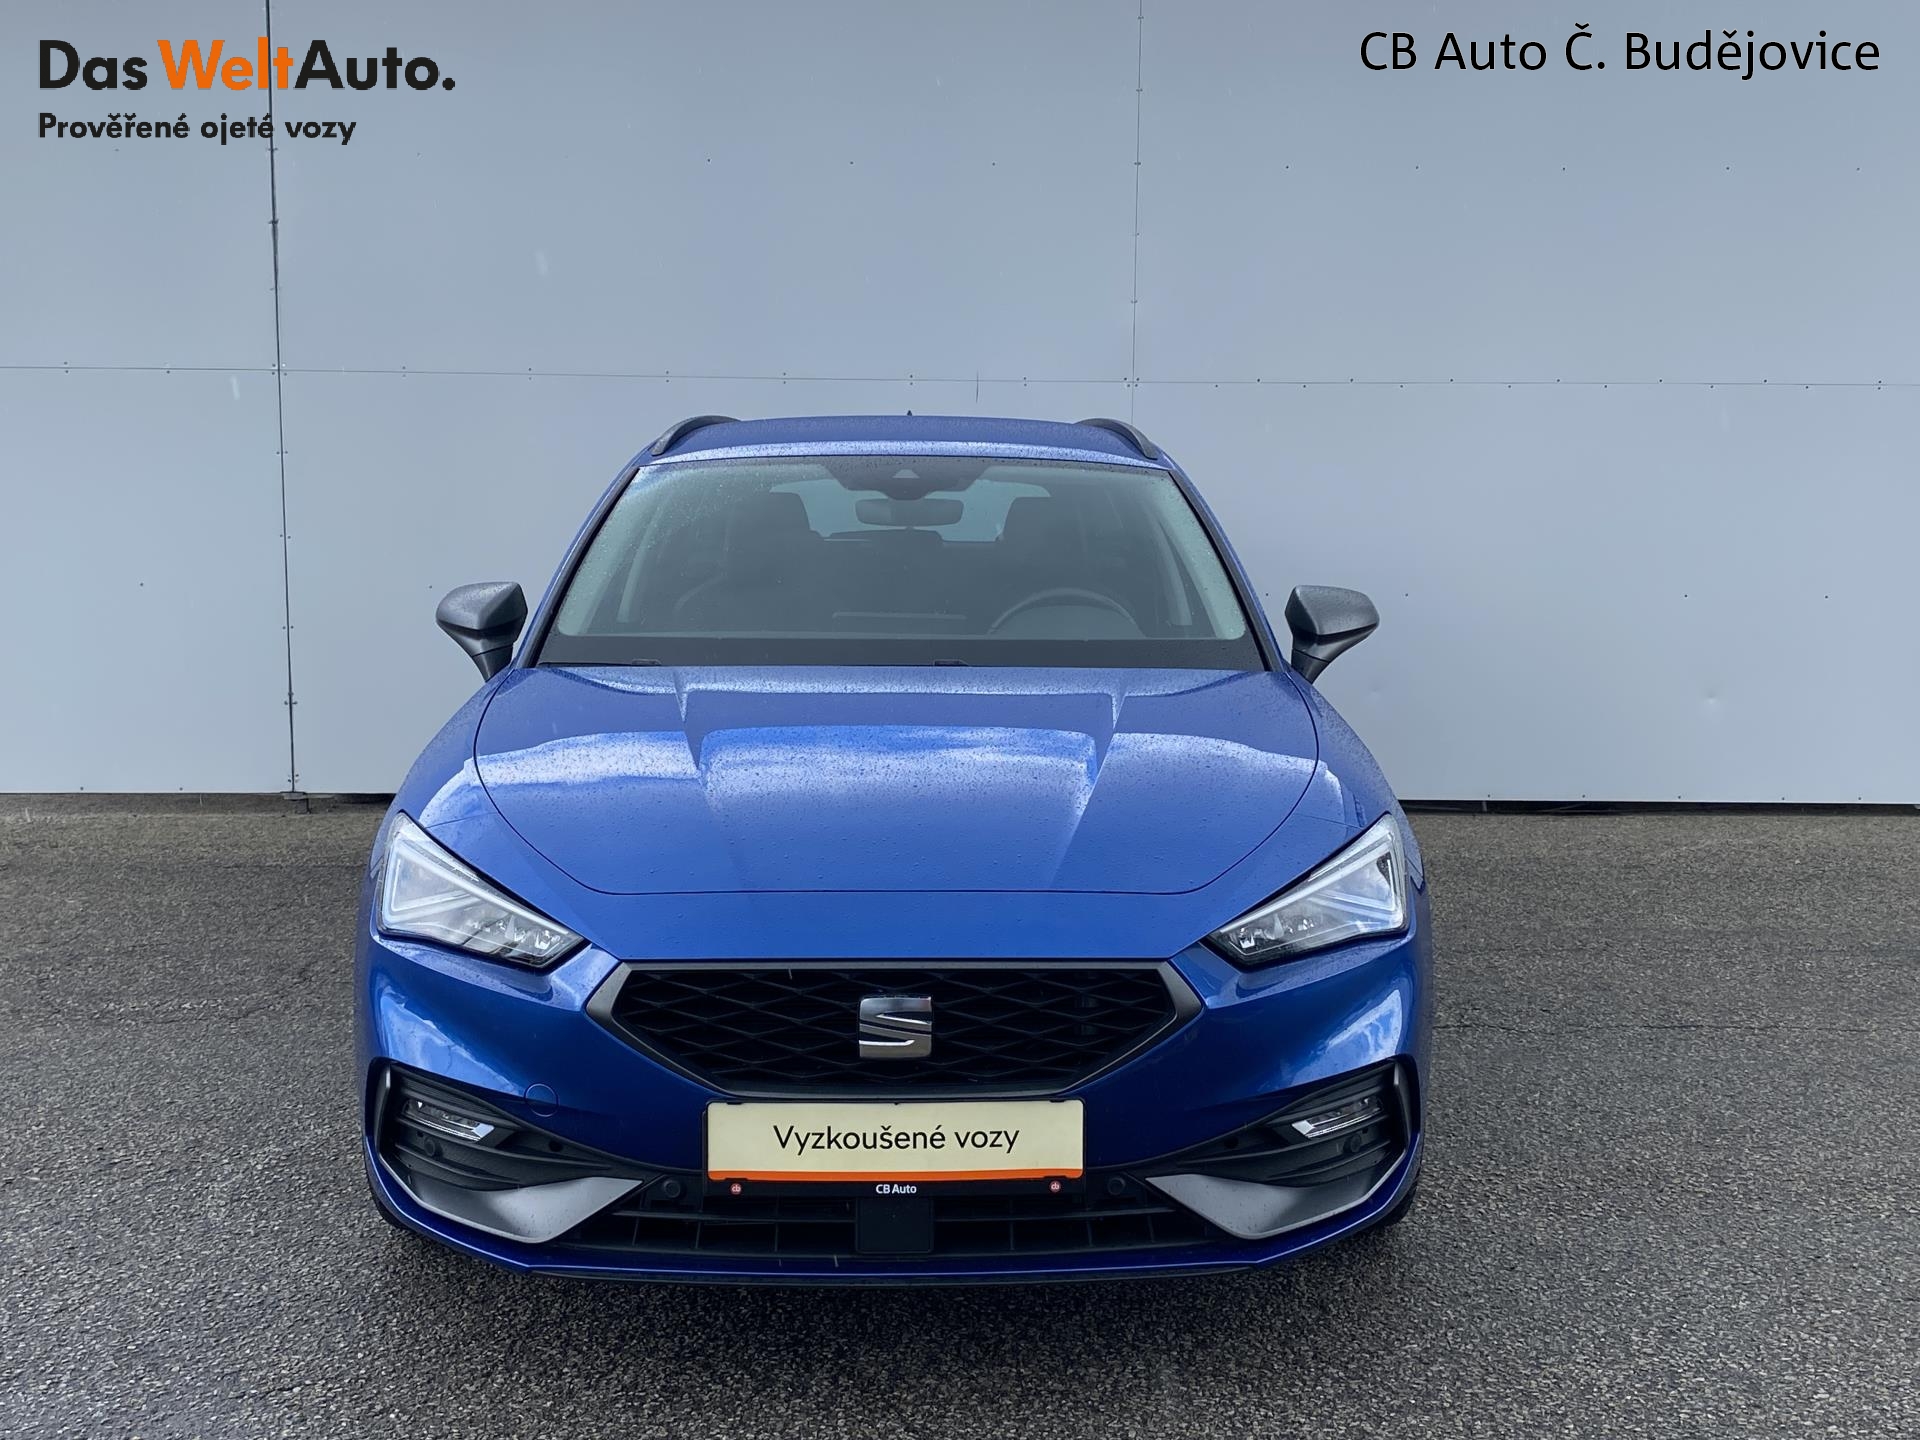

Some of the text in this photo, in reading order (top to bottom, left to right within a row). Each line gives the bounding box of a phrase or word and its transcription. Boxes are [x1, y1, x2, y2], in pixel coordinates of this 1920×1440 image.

[772, 1124, 1020, 1156] Vyzkoušené vozy
[875, 1183, 917, 1195] CB Auto
